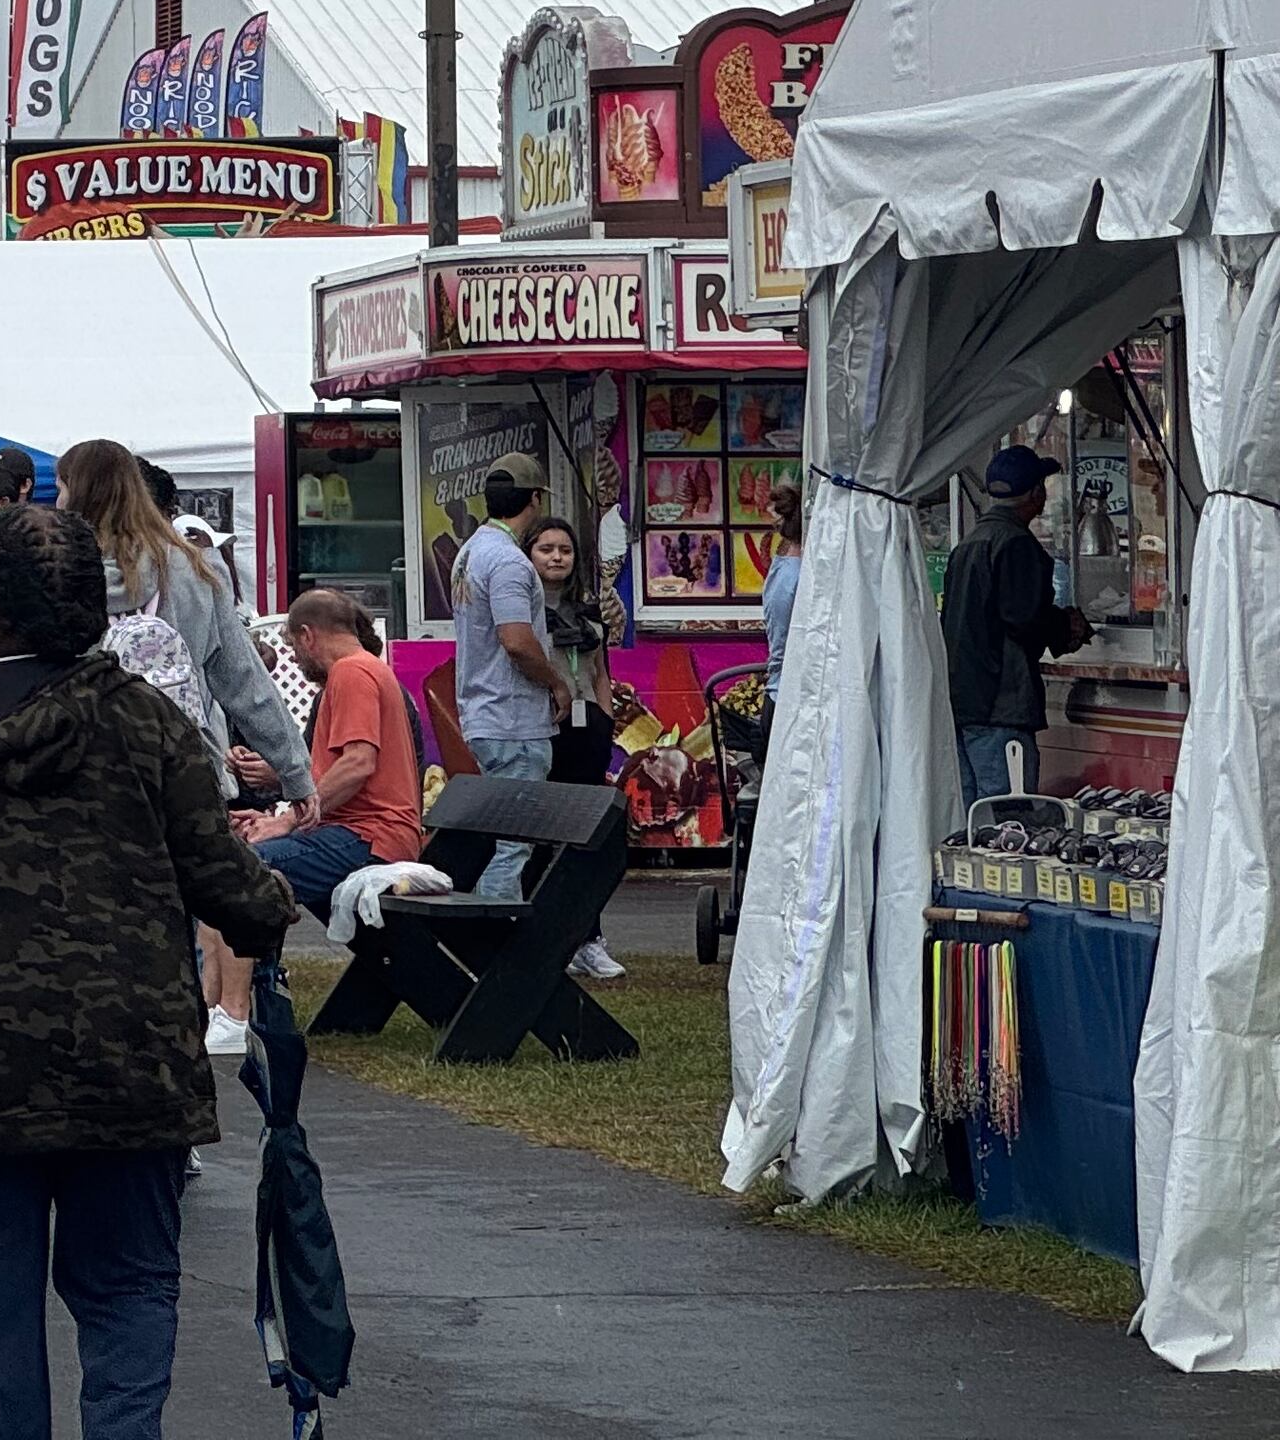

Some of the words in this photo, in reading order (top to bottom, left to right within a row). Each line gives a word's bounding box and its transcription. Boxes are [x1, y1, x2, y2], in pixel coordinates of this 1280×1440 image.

[128, 89, 152, 130] NOO
[194, 72, 217, 129] NOOD
[234, 60, 260, 118] RIC
[26, 170, 47, 210] $
[55, 155, 193, 201] VALUE
[199, 156, 318, 204] MENU
[35, 212, 146, 240] RGERS
[457, 264, 519, 276] CHOCOLATE
[523, 263, 586, 274] COVERED
[457, 274, 641, 345] CHEESECAKE
[363, 428, 385, 439] ICE
[430, 421, 537, 476] STRAWBERRIES
[1104, 459, 1128, 477] BEE
